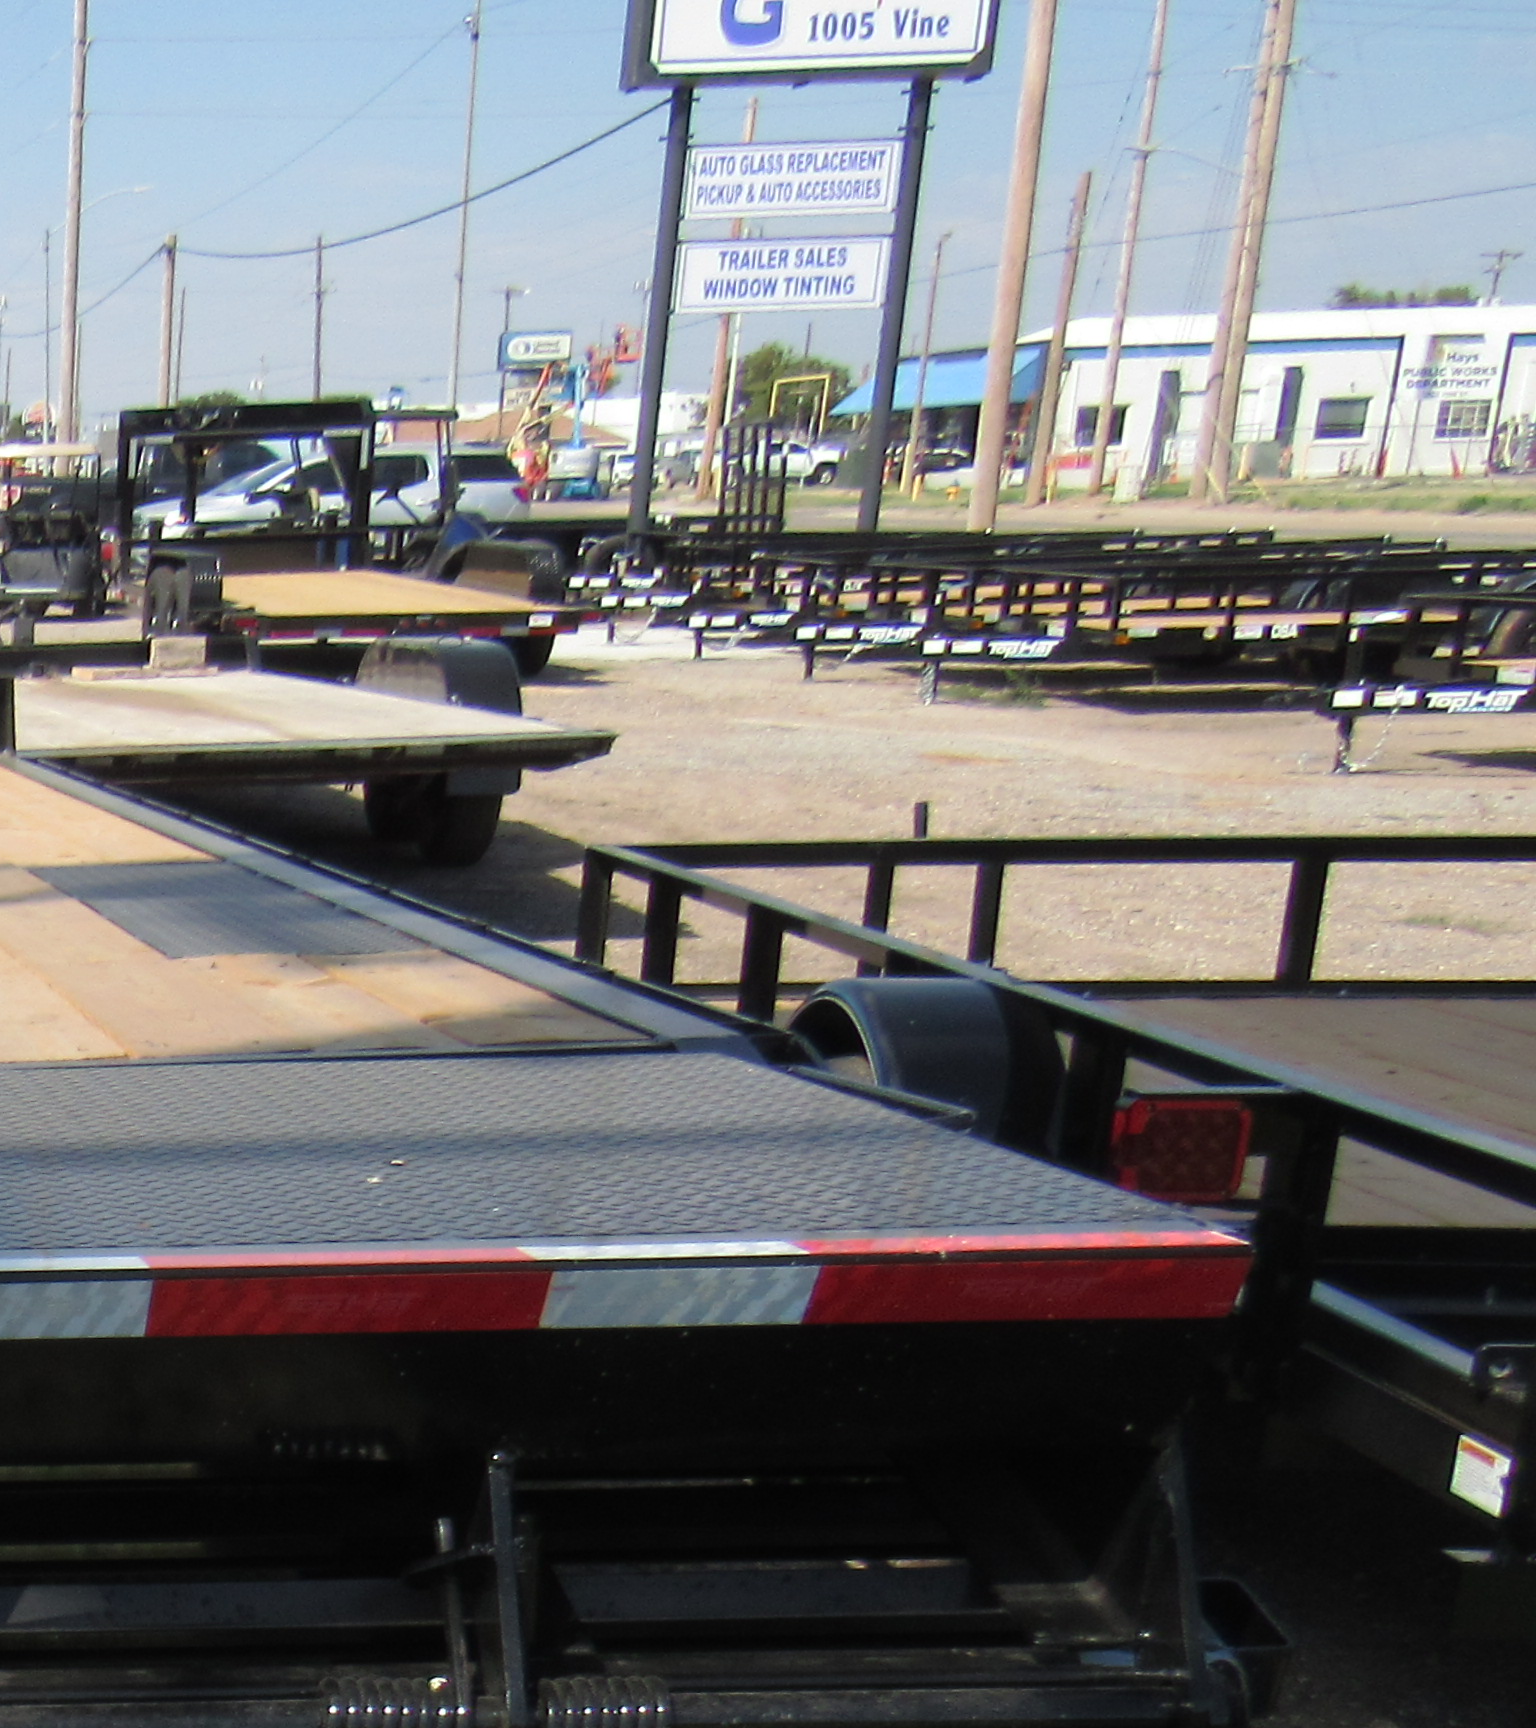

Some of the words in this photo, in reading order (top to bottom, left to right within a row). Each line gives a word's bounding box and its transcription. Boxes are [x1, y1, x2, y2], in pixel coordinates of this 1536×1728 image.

[808, 11, 875, 42] 1005
[893, 8, 950, 39] Vine
[699, 156, 736, 177] AUTO
[739, 152, 784, 176] GLASS
[787, 149, 887, 174] REPLACEMENT
[695, 183, 743, 206] PICKUP
[745, 183, 755, 204] &
[759, 181, 793, 203] AUTO
[795, 178, 882, 201] ACCESSORIES
[718, 248, 789, 271] TRAILER
[794, 246, 848, 269] SALES
[703, 277, 778, 300] WINDOW
[783, 274, 856, 297] TINTING
